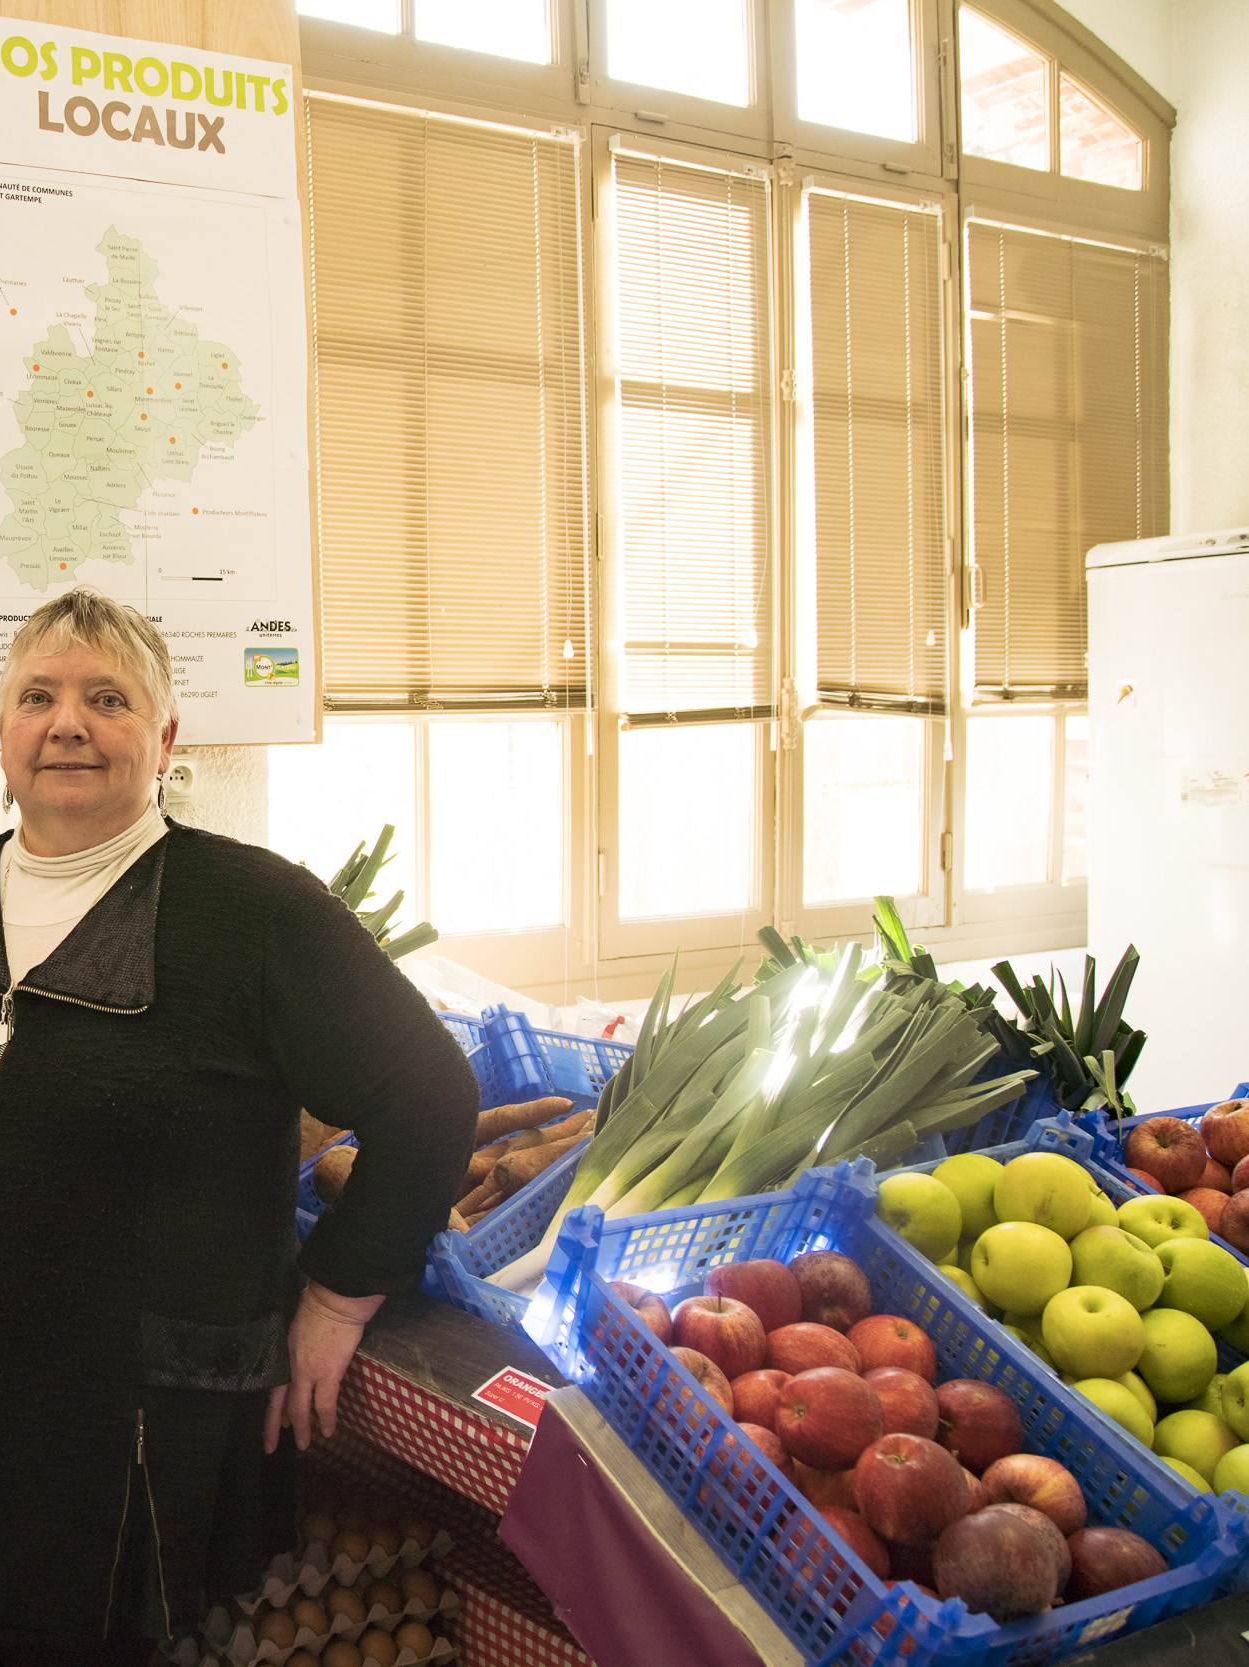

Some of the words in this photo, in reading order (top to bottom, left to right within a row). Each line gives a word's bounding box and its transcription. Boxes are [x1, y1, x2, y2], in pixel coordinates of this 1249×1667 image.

[71, 46, 289, 116] PRODUITS
[38, 90, 226, 154] LOCAUX
[32, 186, 73, 197] COMMUNES
[4, 193, 42, 204] GARTEMPE
[251, 620, 292, 632] ANDES
